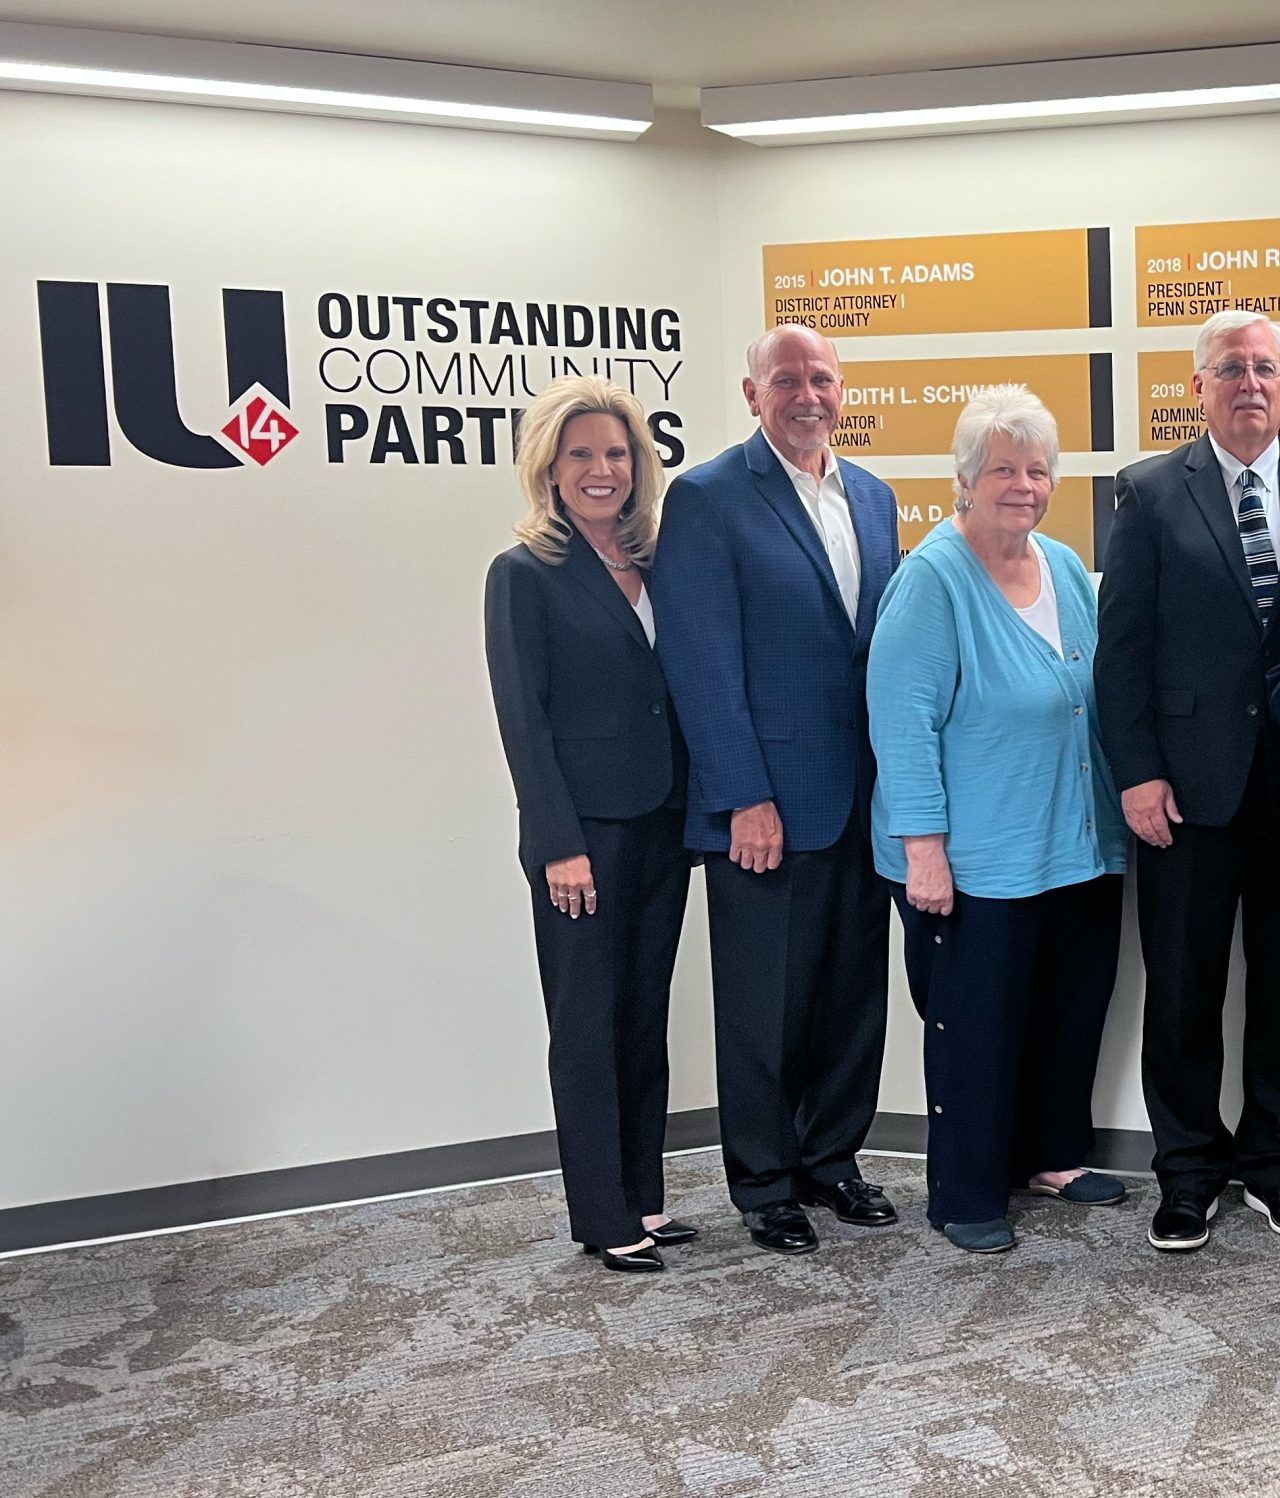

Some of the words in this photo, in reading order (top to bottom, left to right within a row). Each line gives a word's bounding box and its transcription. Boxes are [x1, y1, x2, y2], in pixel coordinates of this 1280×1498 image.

[1147, 257, 1182, 273] 2018
[1196, 249, 1258, 272] JOHN
[775, 275, 806, 289] 2015
[818, 267, 874, 288] JOHN
[879, 266, 896, 285] T.
[900, 262, 975, 284] ADAMS
[1148, 281, 1224, 299] PRESIDENT
[775, 297, 830, 312] DISTRICT
[833, 294, 897, 311] ATTORNEY
[1148, 301, 1185, 317] PENN
[1189, 299, 1231, 315] STATE
[317, 292, 682, 352] OUTSTANDING
[820, 312, 870, 328] COUNTY
[900, 387, 917, 405] L.
[1151, 383, 1185, 398] 2019
[234, 402, 288, 454] 14
[327, 404, 686, 468] PARTS
